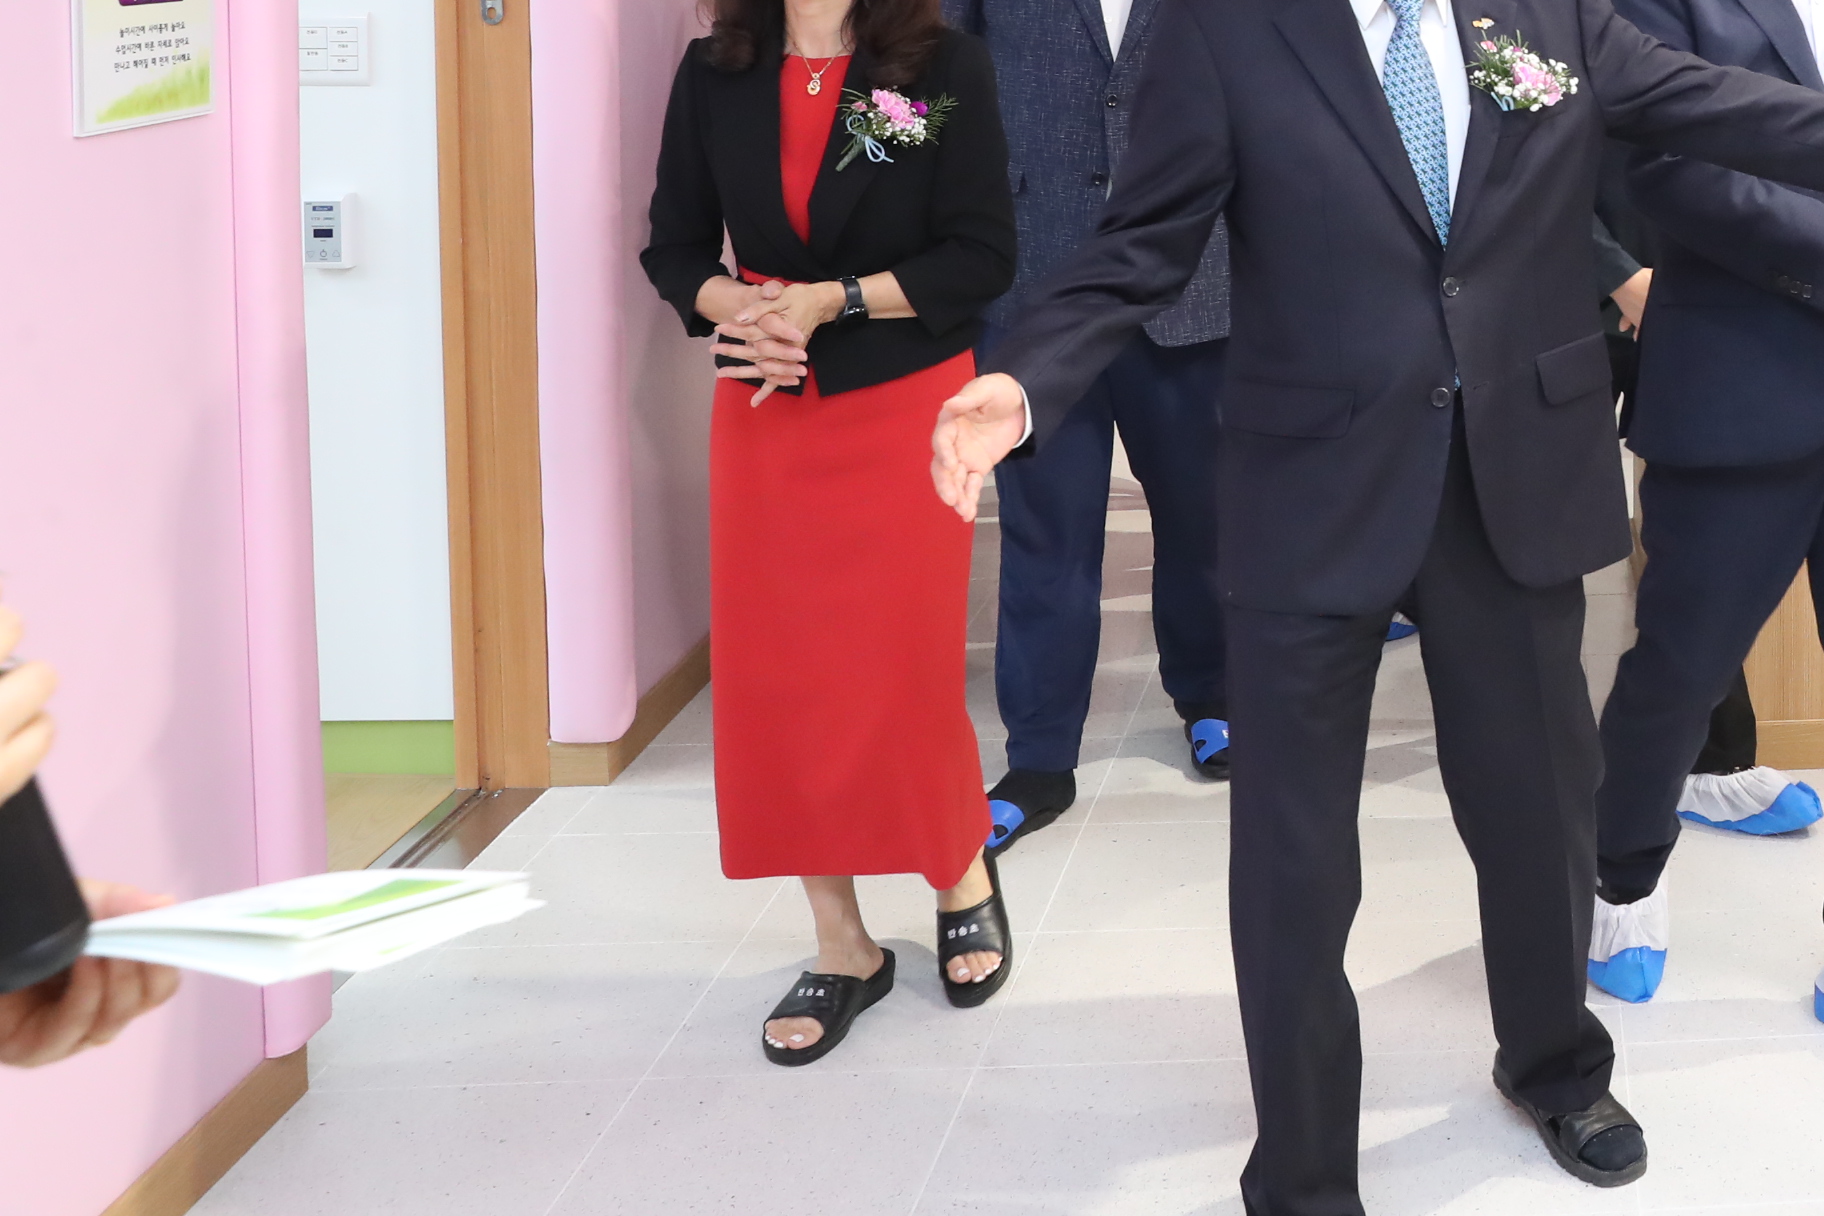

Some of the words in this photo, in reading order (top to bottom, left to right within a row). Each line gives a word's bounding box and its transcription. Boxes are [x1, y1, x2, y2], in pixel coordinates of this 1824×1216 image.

[119, 25, 146, 38] 놀이시간에
[148, 23, 169, 34] 사이좋게
[171, 21, 185, 32] 놀아요
[115, 42, 142, 55] 수업시간에
[144, 41, 155, 51] 바른
[157, 39, 172, 49] 자세로
[174, 37, 190, 48] 앉아요
[114, 61, 130, 73] 만나고
[133, 58, 149, 68] 헤어질
[151, 57, 157, 66] 때
[159, 55, 169, 67] 먼저
[171, 53, 191, 65] 인사해요
